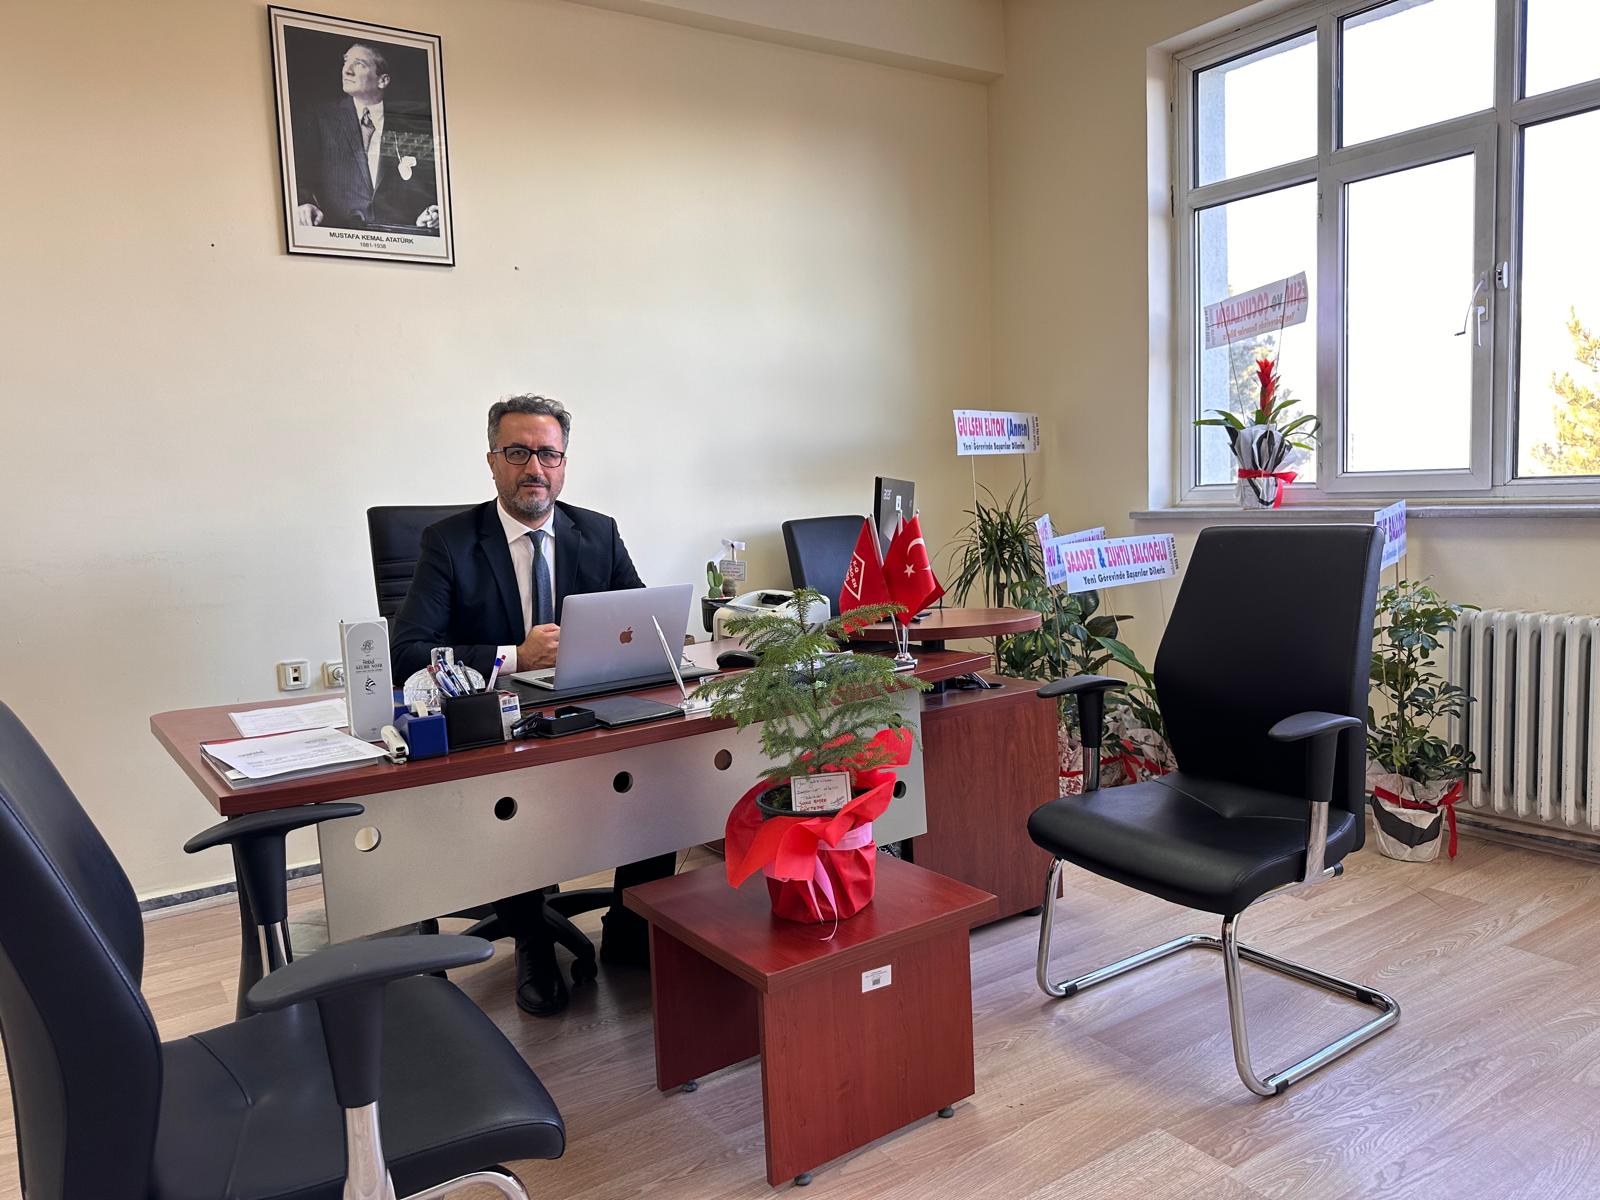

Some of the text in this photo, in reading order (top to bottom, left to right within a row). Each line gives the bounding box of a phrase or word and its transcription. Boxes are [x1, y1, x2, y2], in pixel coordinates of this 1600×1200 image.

[329, 232, 414, 244] MUSTAFA KEMAL ATATÜRK
[1006, 417, 1030, 440] (Annen)
[963, 442, 972, 450] Yeni
[1064, 548, 1097, 573] SAADET
[1097, 547, 1107, 569] &
[1082, 566, 1166, 585] Yeni Görevinde Başarılar Dileriz
